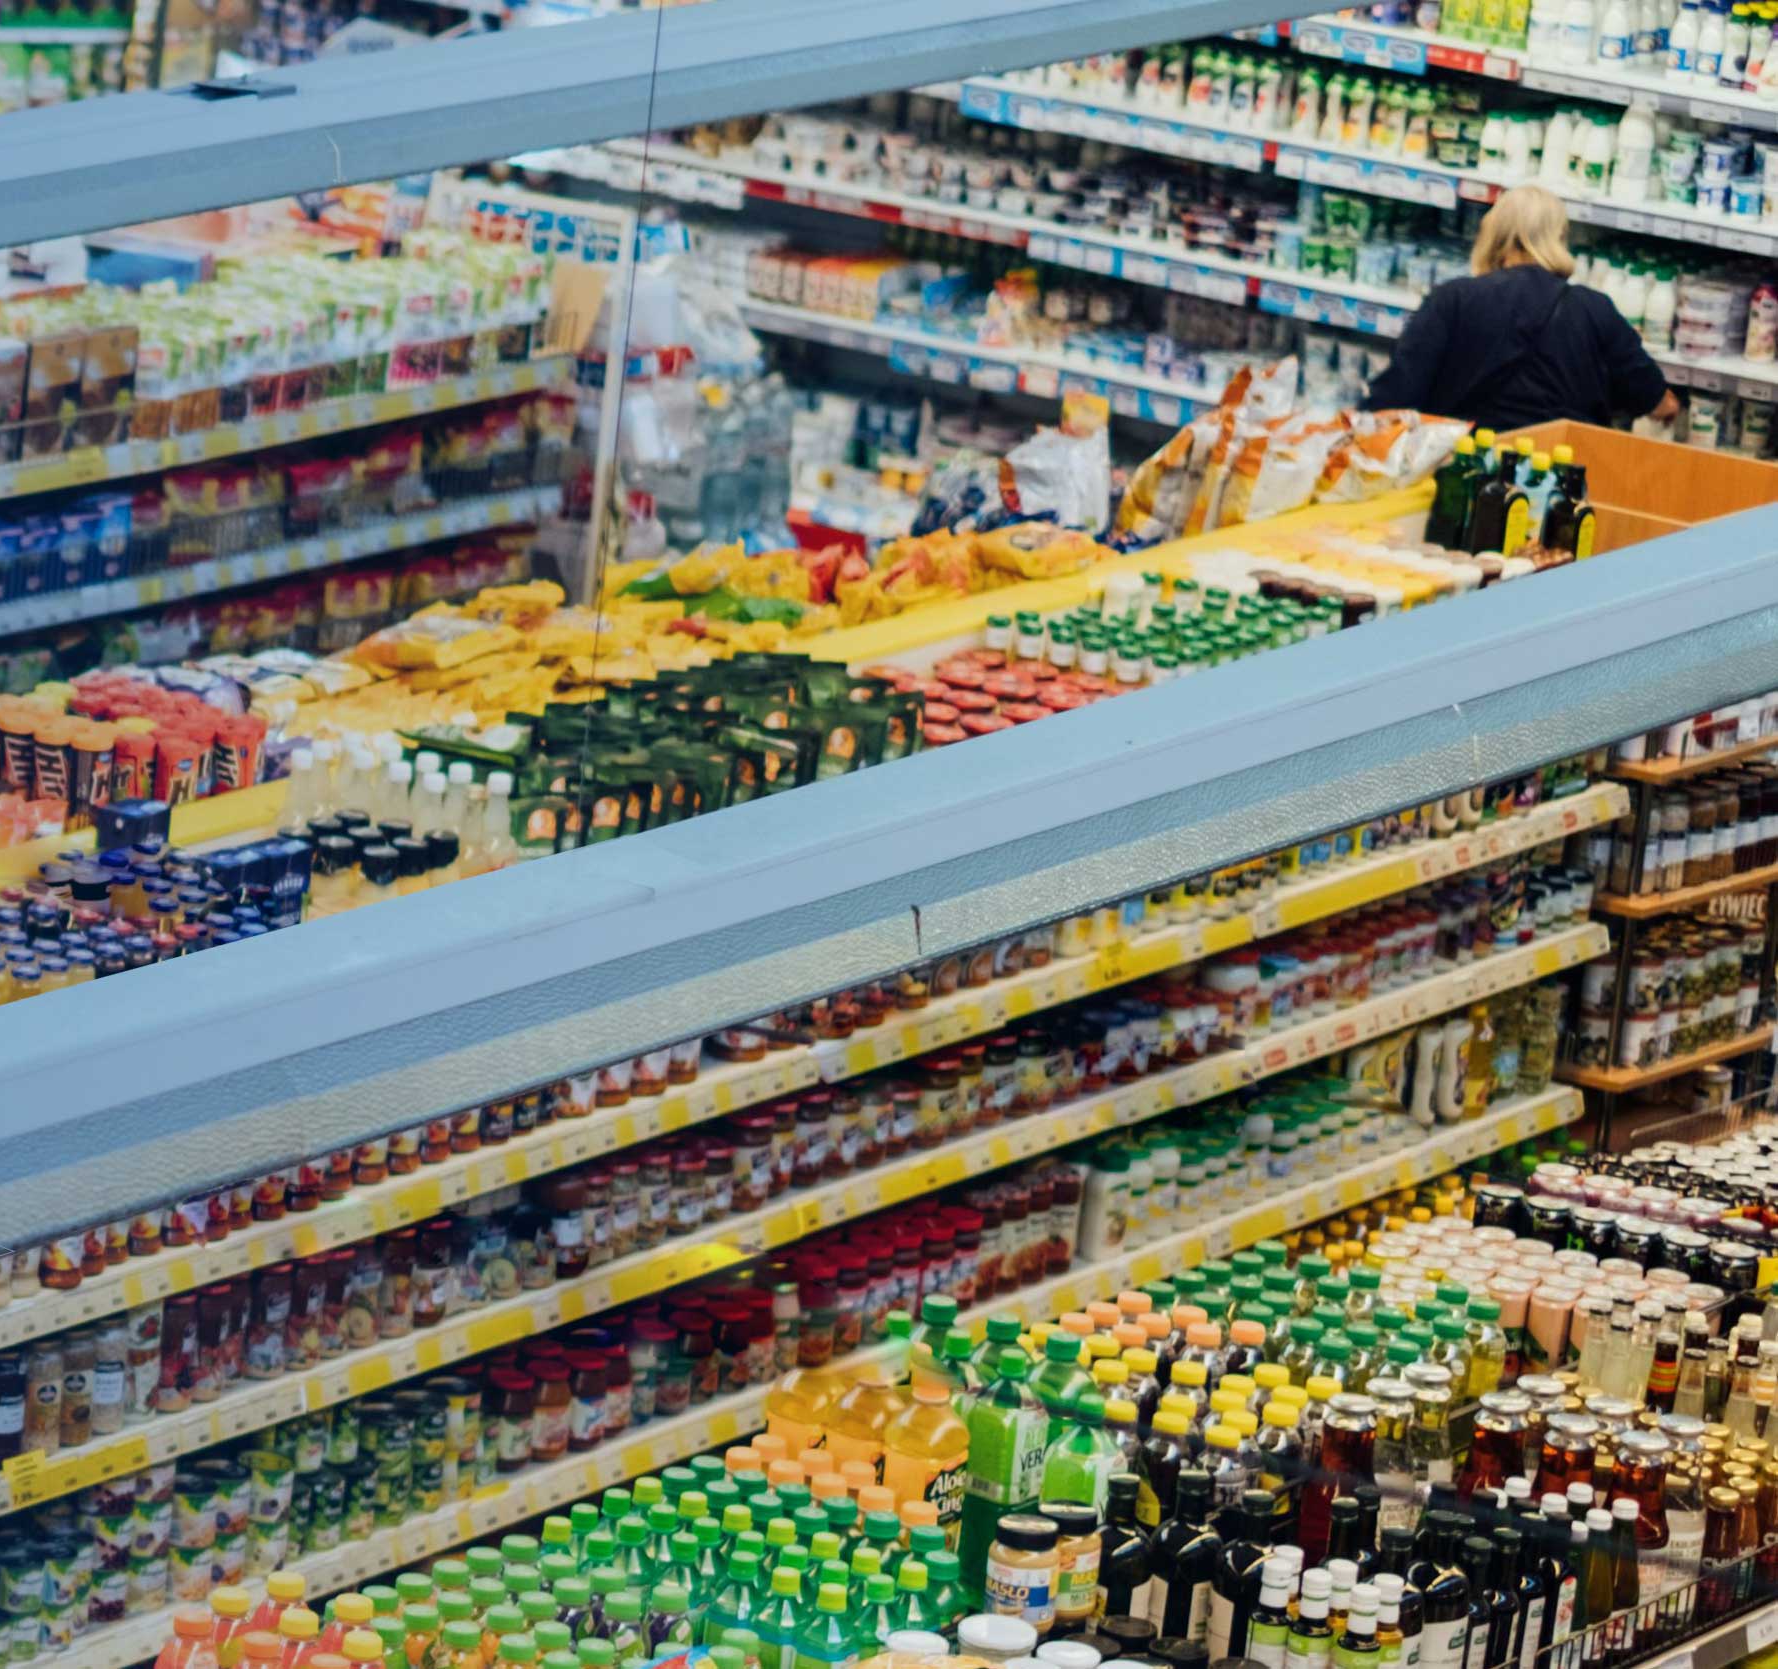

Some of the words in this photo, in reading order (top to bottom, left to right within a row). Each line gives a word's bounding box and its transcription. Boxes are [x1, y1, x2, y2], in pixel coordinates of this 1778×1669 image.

[33, 744, 69, 800] Hit
[1019, 1446, 1051, 1473] VER
[928, 1469, 967, 1498] Aloe
